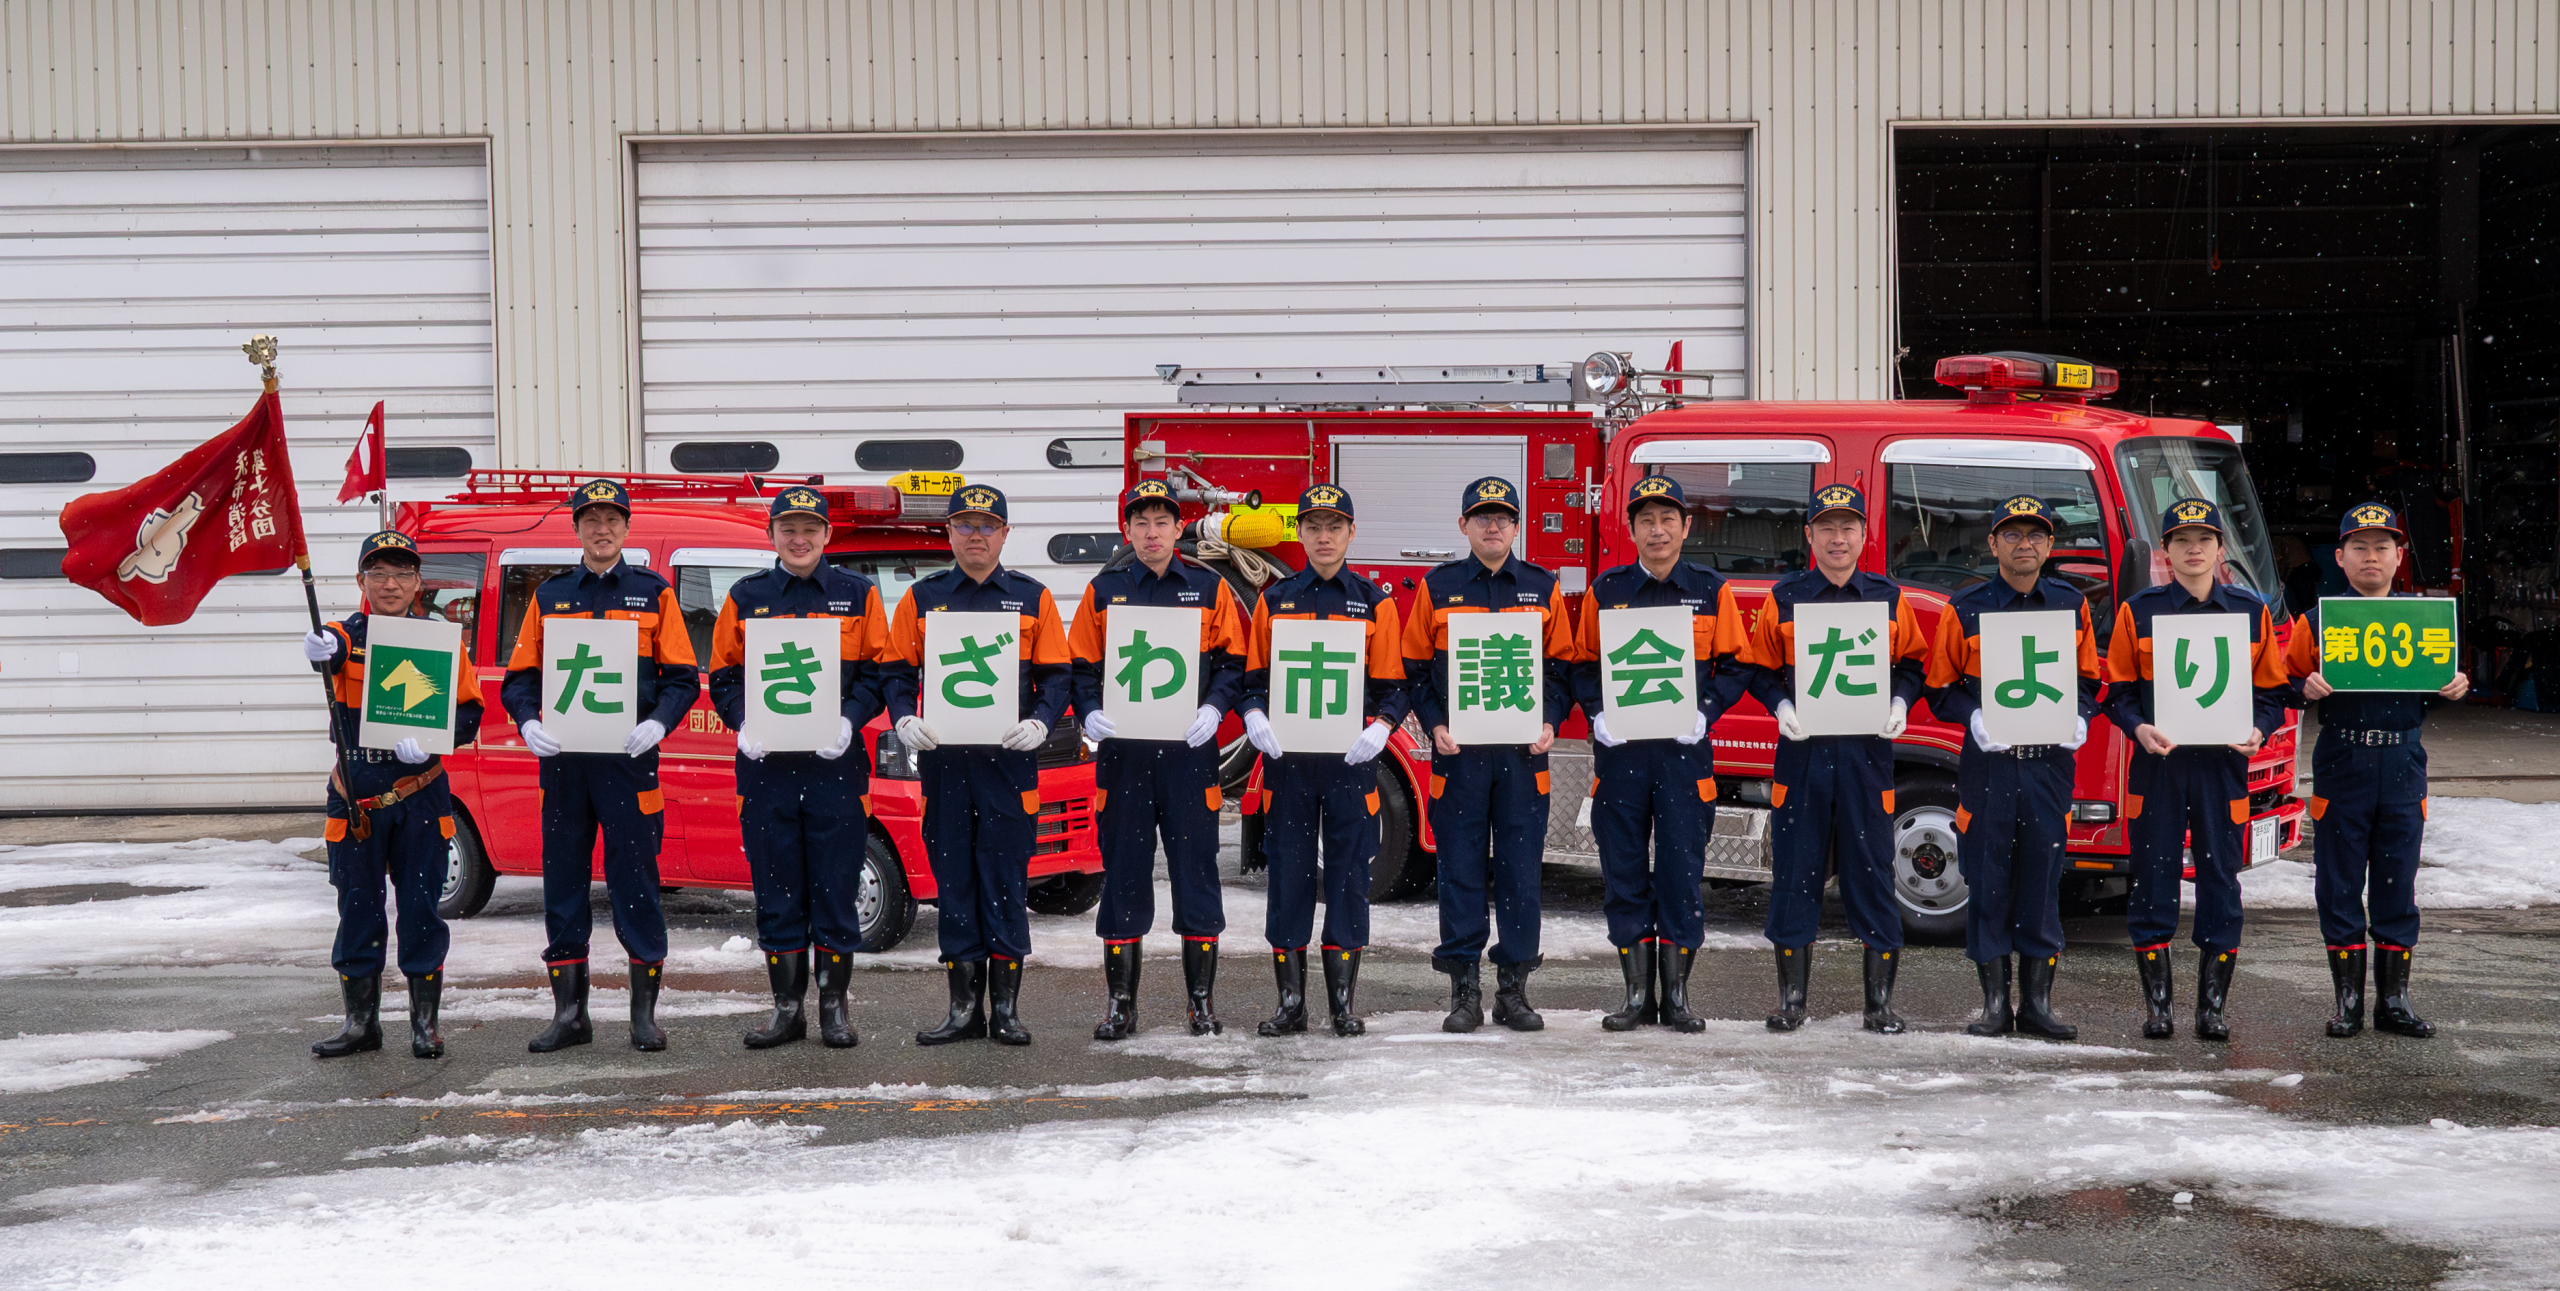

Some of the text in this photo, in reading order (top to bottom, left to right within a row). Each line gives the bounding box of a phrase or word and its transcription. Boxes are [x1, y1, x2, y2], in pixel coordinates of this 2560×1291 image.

[2062, 366, 2088, 386] 第十一分団
[910, 474, 962, 492] 第十一分団
[555, 644, 623, 714] た
[761, 642, 822, 715] き
[939, 632, 1014, 708] ざ
[1116, 630, 1186, 702] わ
[1279, 642, 1355, 719] 市
[1457, 634, 1535, 712] 議
[1608, 629, 1684, 707] 会
[1808, 628, 1876, 698] だ
[1995, 636, 2063, 708] よ
[2175, 637, 2229, 708] り
[2323, 622, 2455, 667] 第63号
